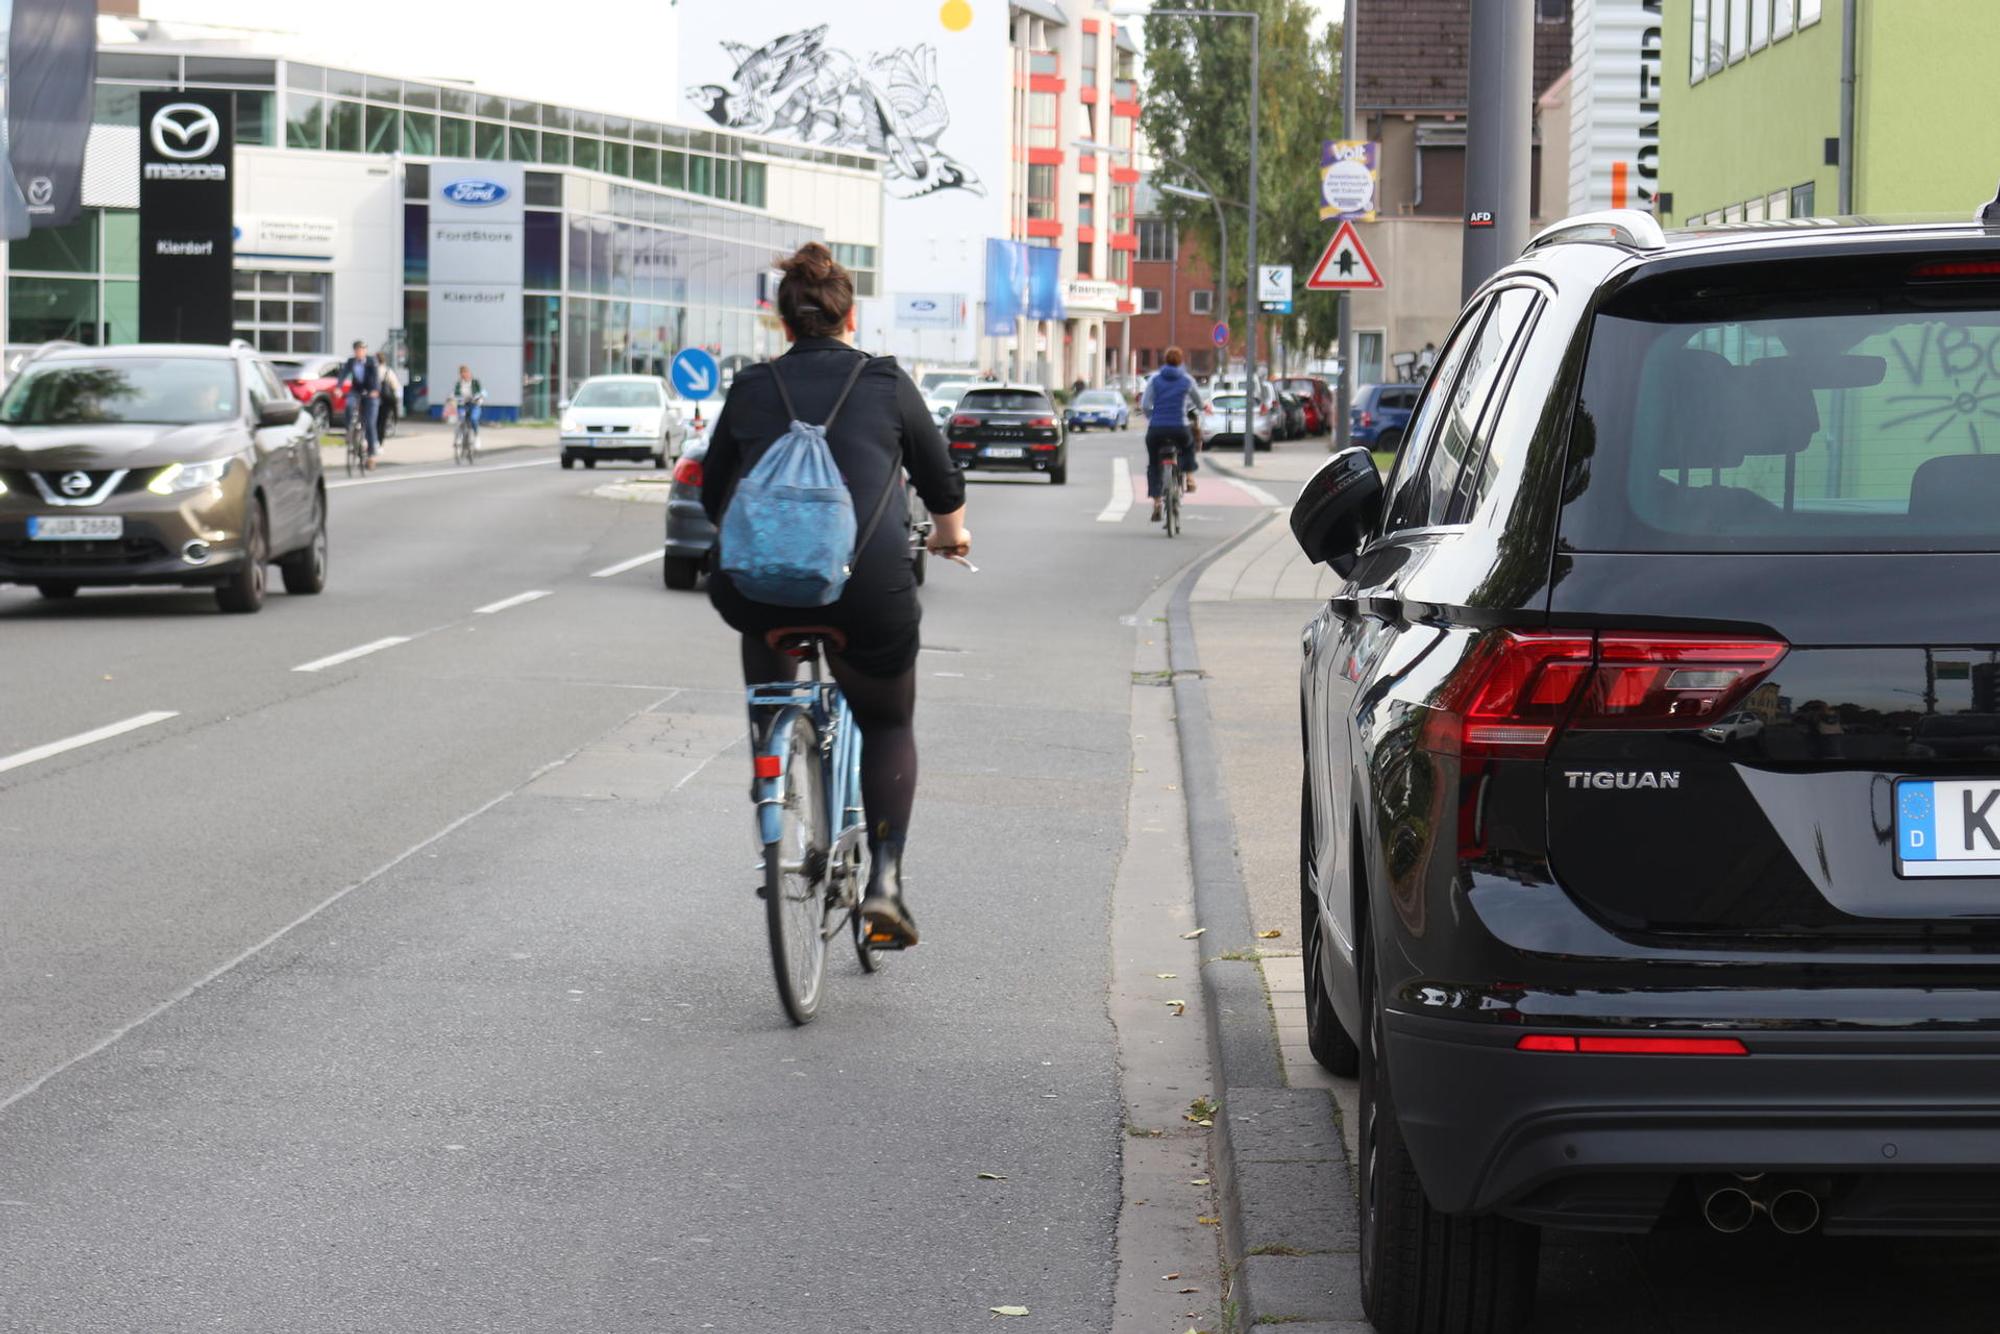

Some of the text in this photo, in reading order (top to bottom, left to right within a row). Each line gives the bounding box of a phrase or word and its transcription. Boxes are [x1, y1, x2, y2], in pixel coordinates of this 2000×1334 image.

[1332, 144, 1367, 161] Volt
[144, 163, 226, 180] mazda
[452, 183, 497, 201] Ford
[1470, 211, 1492, 222] AFD
[437, 231, 513, 243] FordStore
[157, 240, 213, 255] Kierdorf
[443, 291, 505, 304] Kierdorf
[1563, 771, 1681, 789] TIGUAN
[1910, 789, 2000, 851] D K
